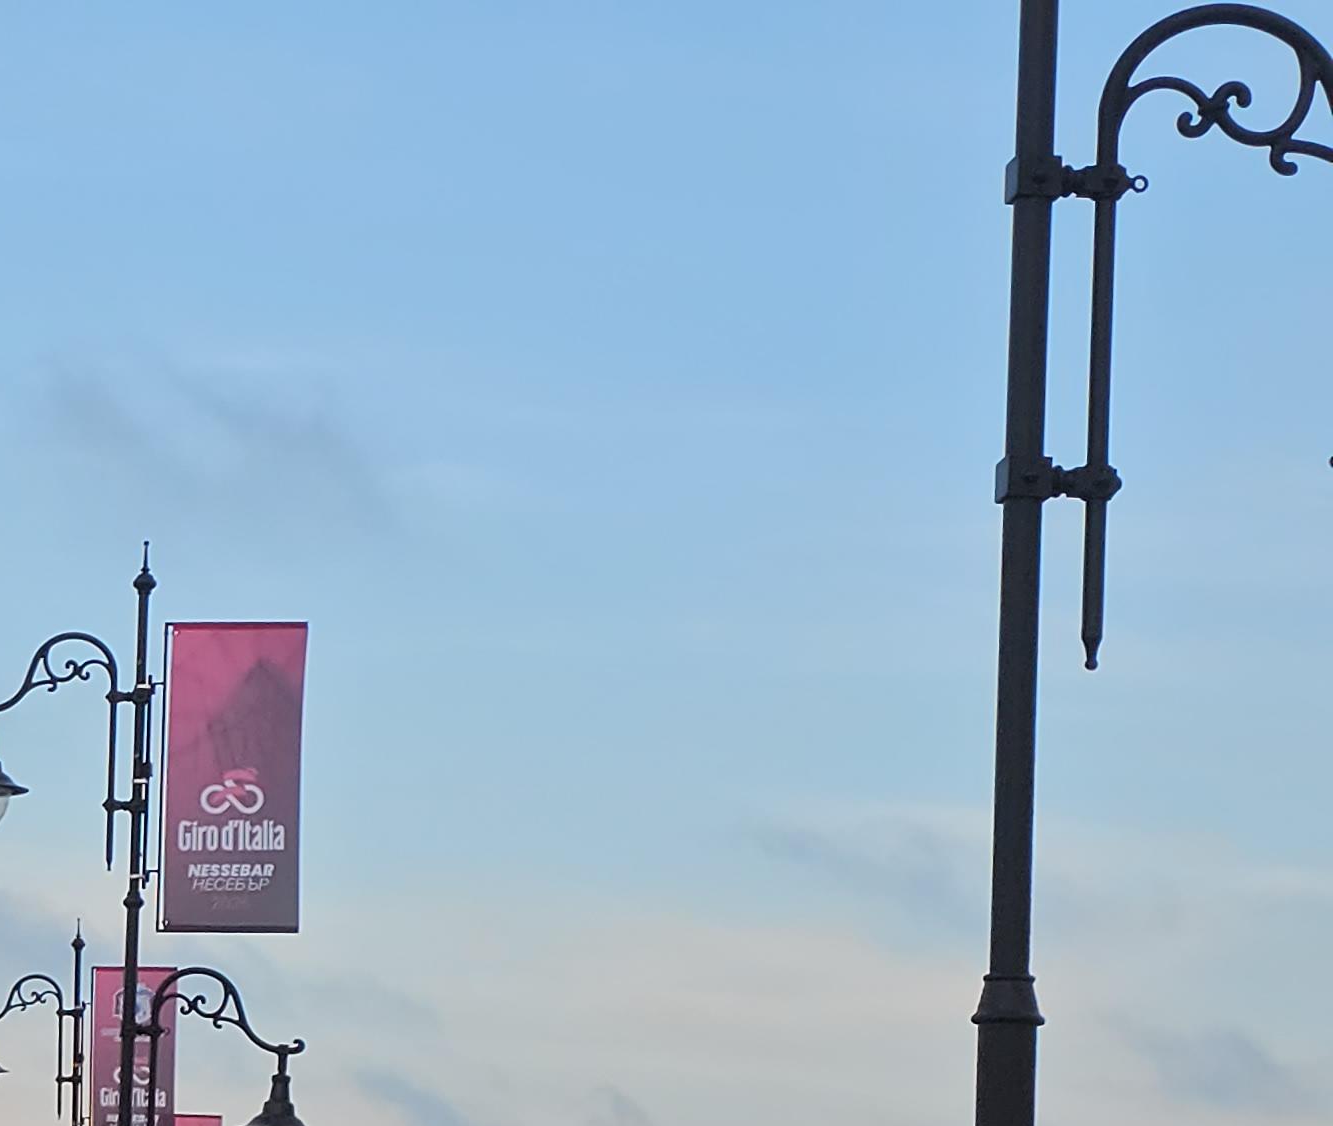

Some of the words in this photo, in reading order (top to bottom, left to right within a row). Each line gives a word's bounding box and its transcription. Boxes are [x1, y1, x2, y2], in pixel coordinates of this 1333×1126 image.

[177, 819, 218, 851] Giro
[221, 818, 285, 851] d'Italia
[188, 864, 275, 878] NESSEBAR
[192, 877, 270, 891] НЕСЕБЪР
[100, 1087, 121, 1107] Gir
